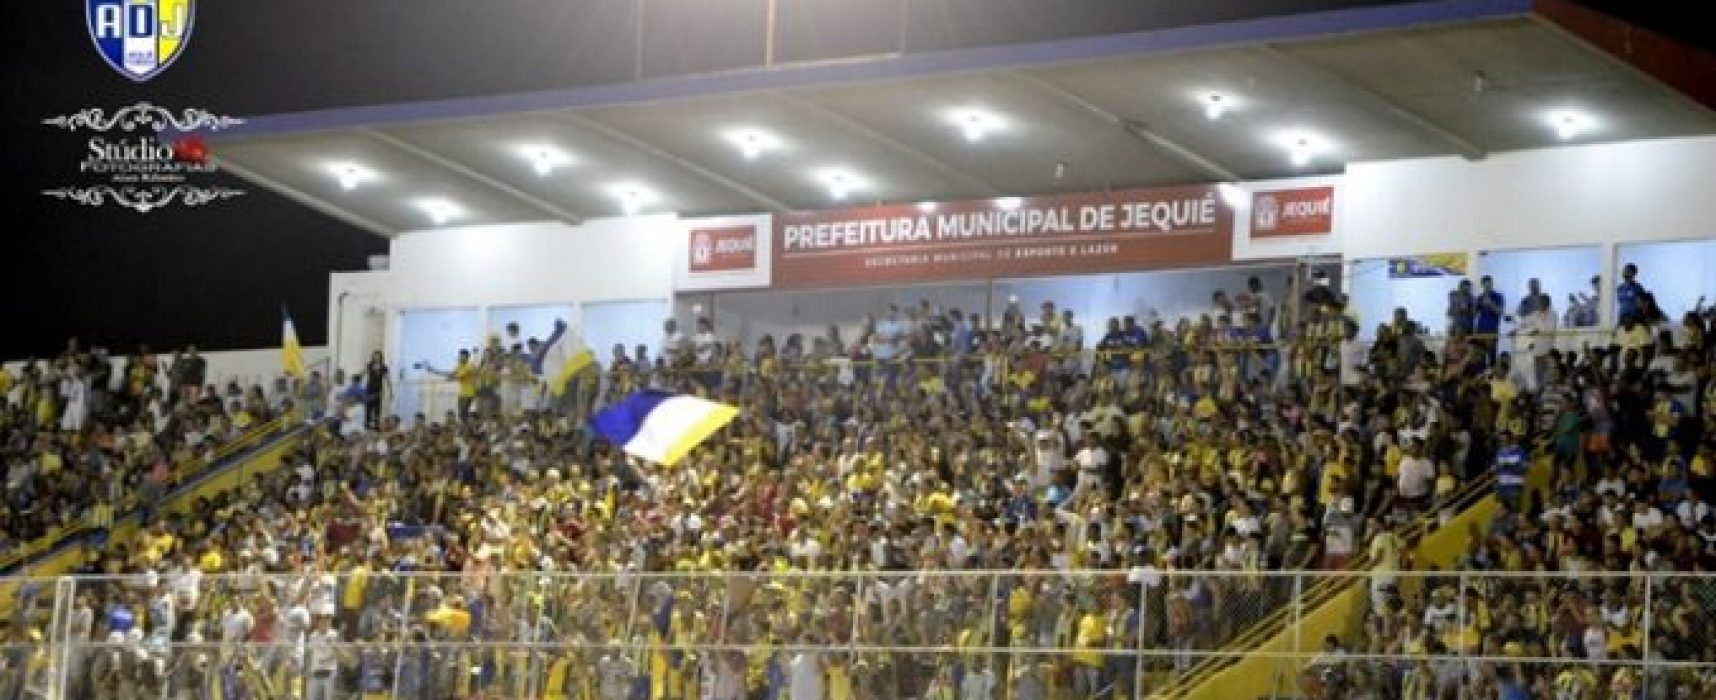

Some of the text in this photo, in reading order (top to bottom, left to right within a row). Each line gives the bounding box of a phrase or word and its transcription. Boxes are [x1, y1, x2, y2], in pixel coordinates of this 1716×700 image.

[783, 191, 1216, 251] PREFEITURA MUNICIPAL DE JEQUIÉ
